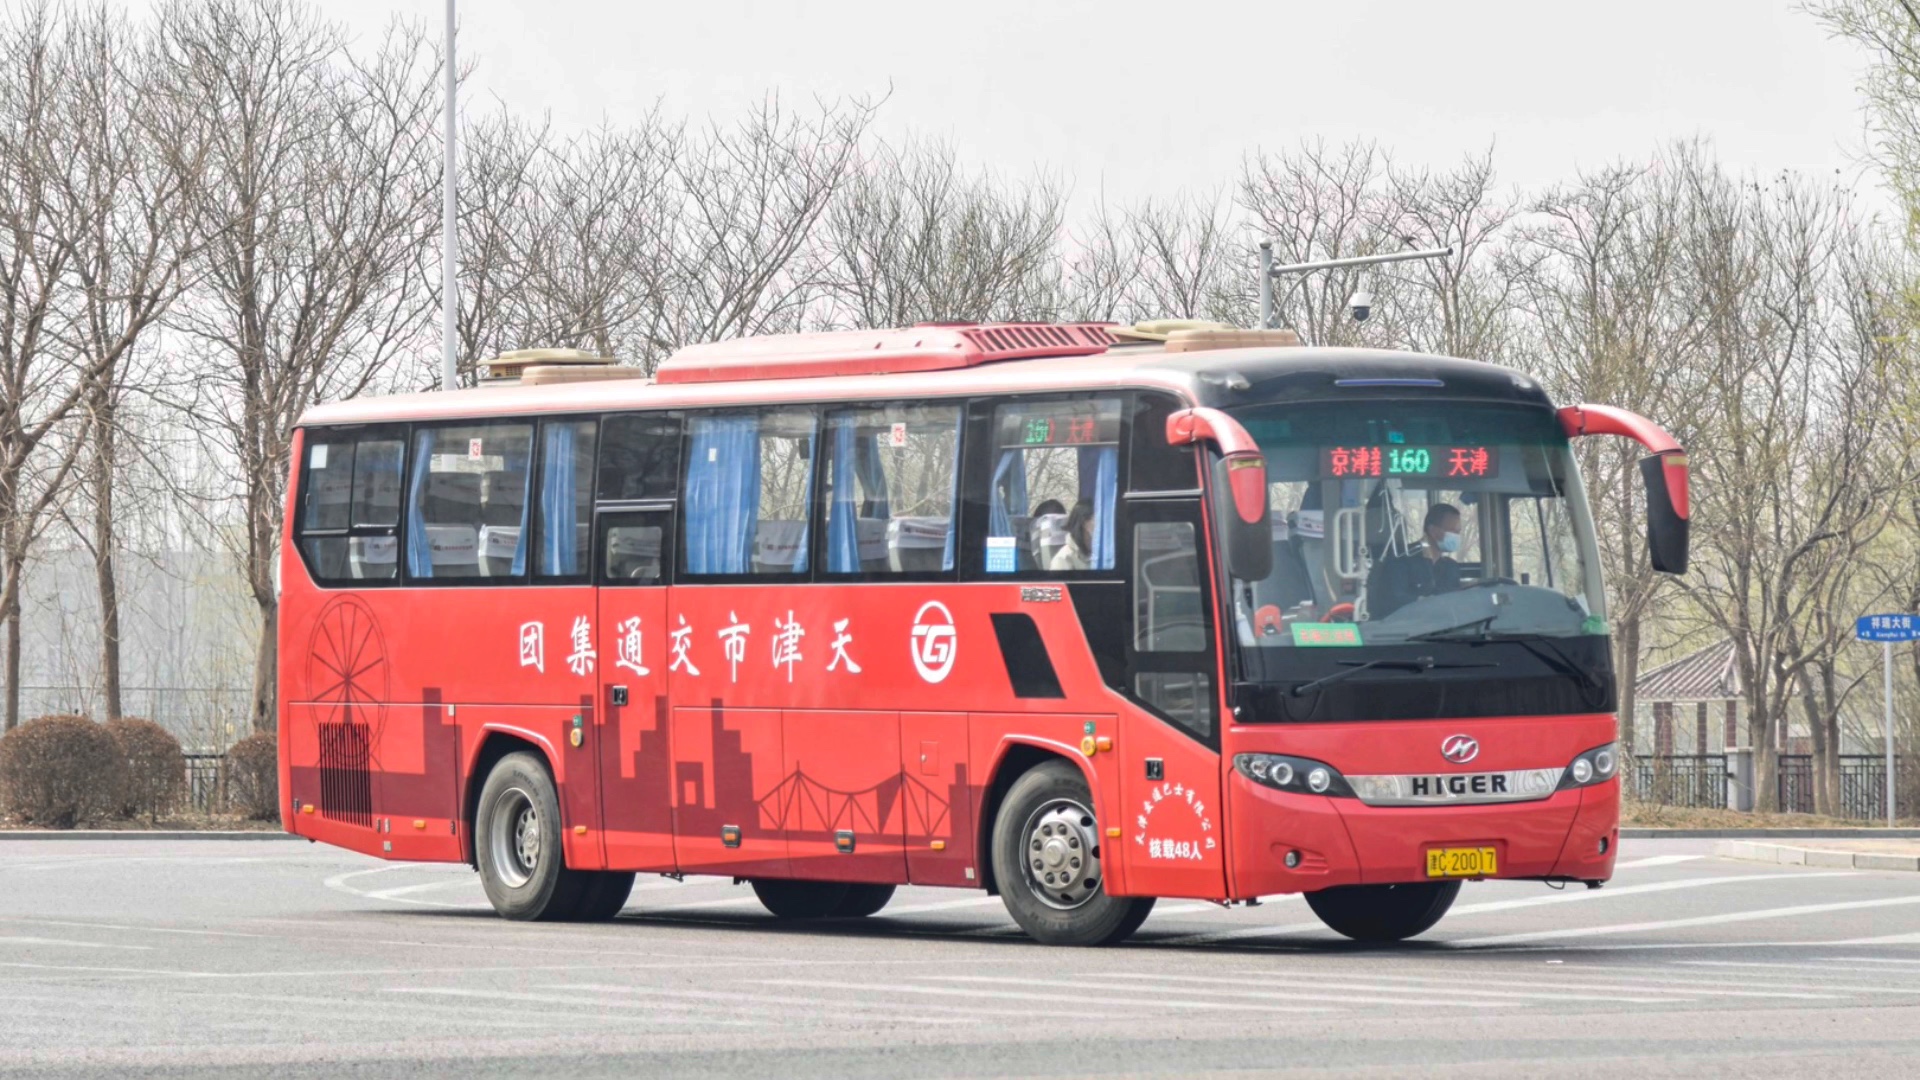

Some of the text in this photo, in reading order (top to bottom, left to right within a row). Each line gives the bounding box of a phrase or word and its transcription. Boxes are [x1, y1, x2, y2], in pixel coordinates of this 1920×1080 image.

[1388, 448, 1431, 473] 160
[1449, 447, 1489, 477] 天津
[1412, 774, 1508, 796] HIGER
[1149, 838, 1203, 861] 核载48人
